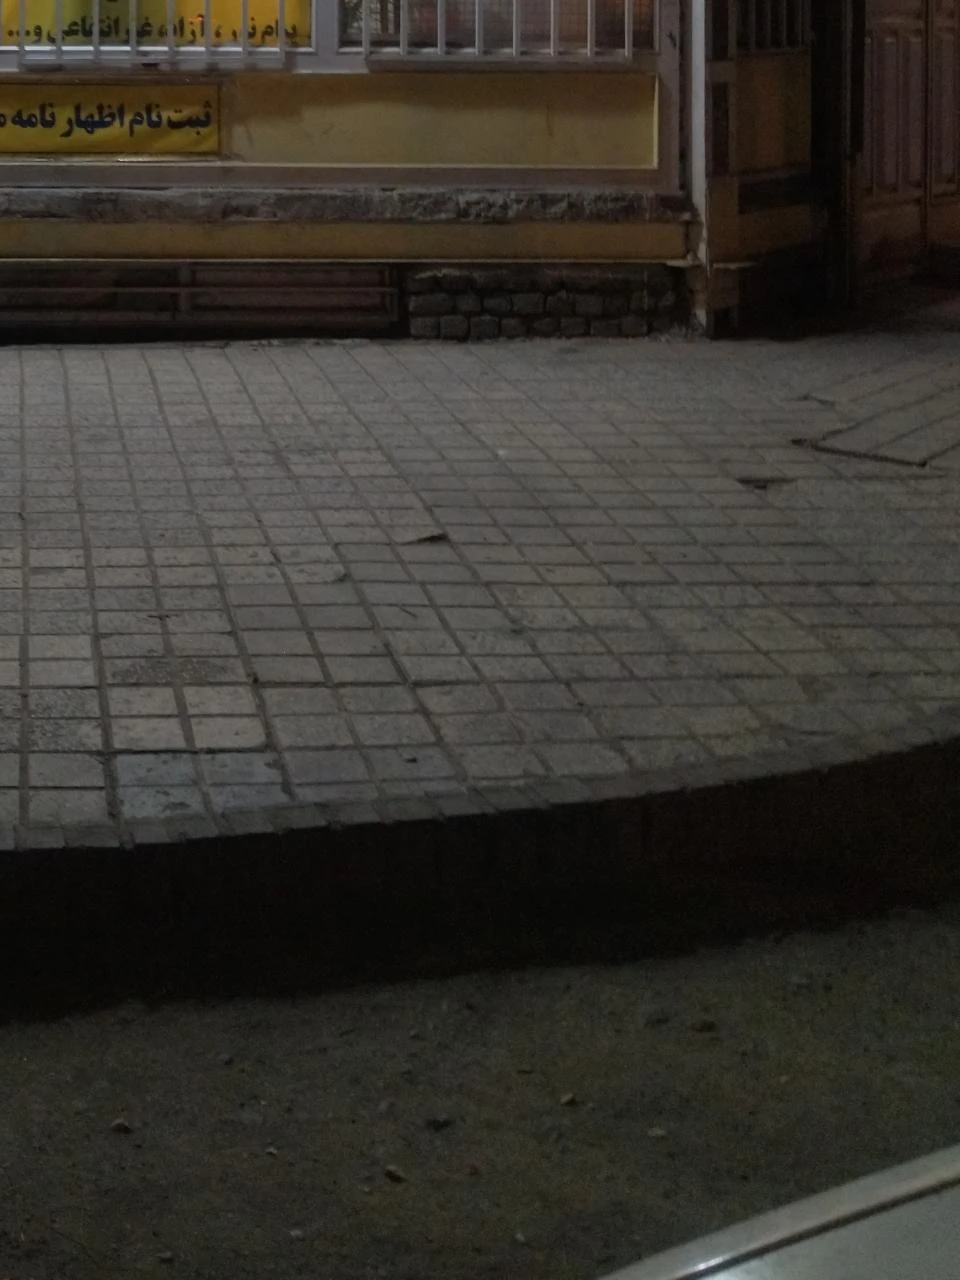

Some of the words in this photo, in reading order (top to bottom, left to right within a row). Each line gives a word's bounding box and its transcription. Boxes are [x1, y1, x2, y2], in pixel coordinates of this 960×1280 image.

[10, 101, 56, 129] نامه
[59, 102, 126, 138] اظهار
[128, 102, 163, 138] نام
[166, 100, 213, 136] ثبت
